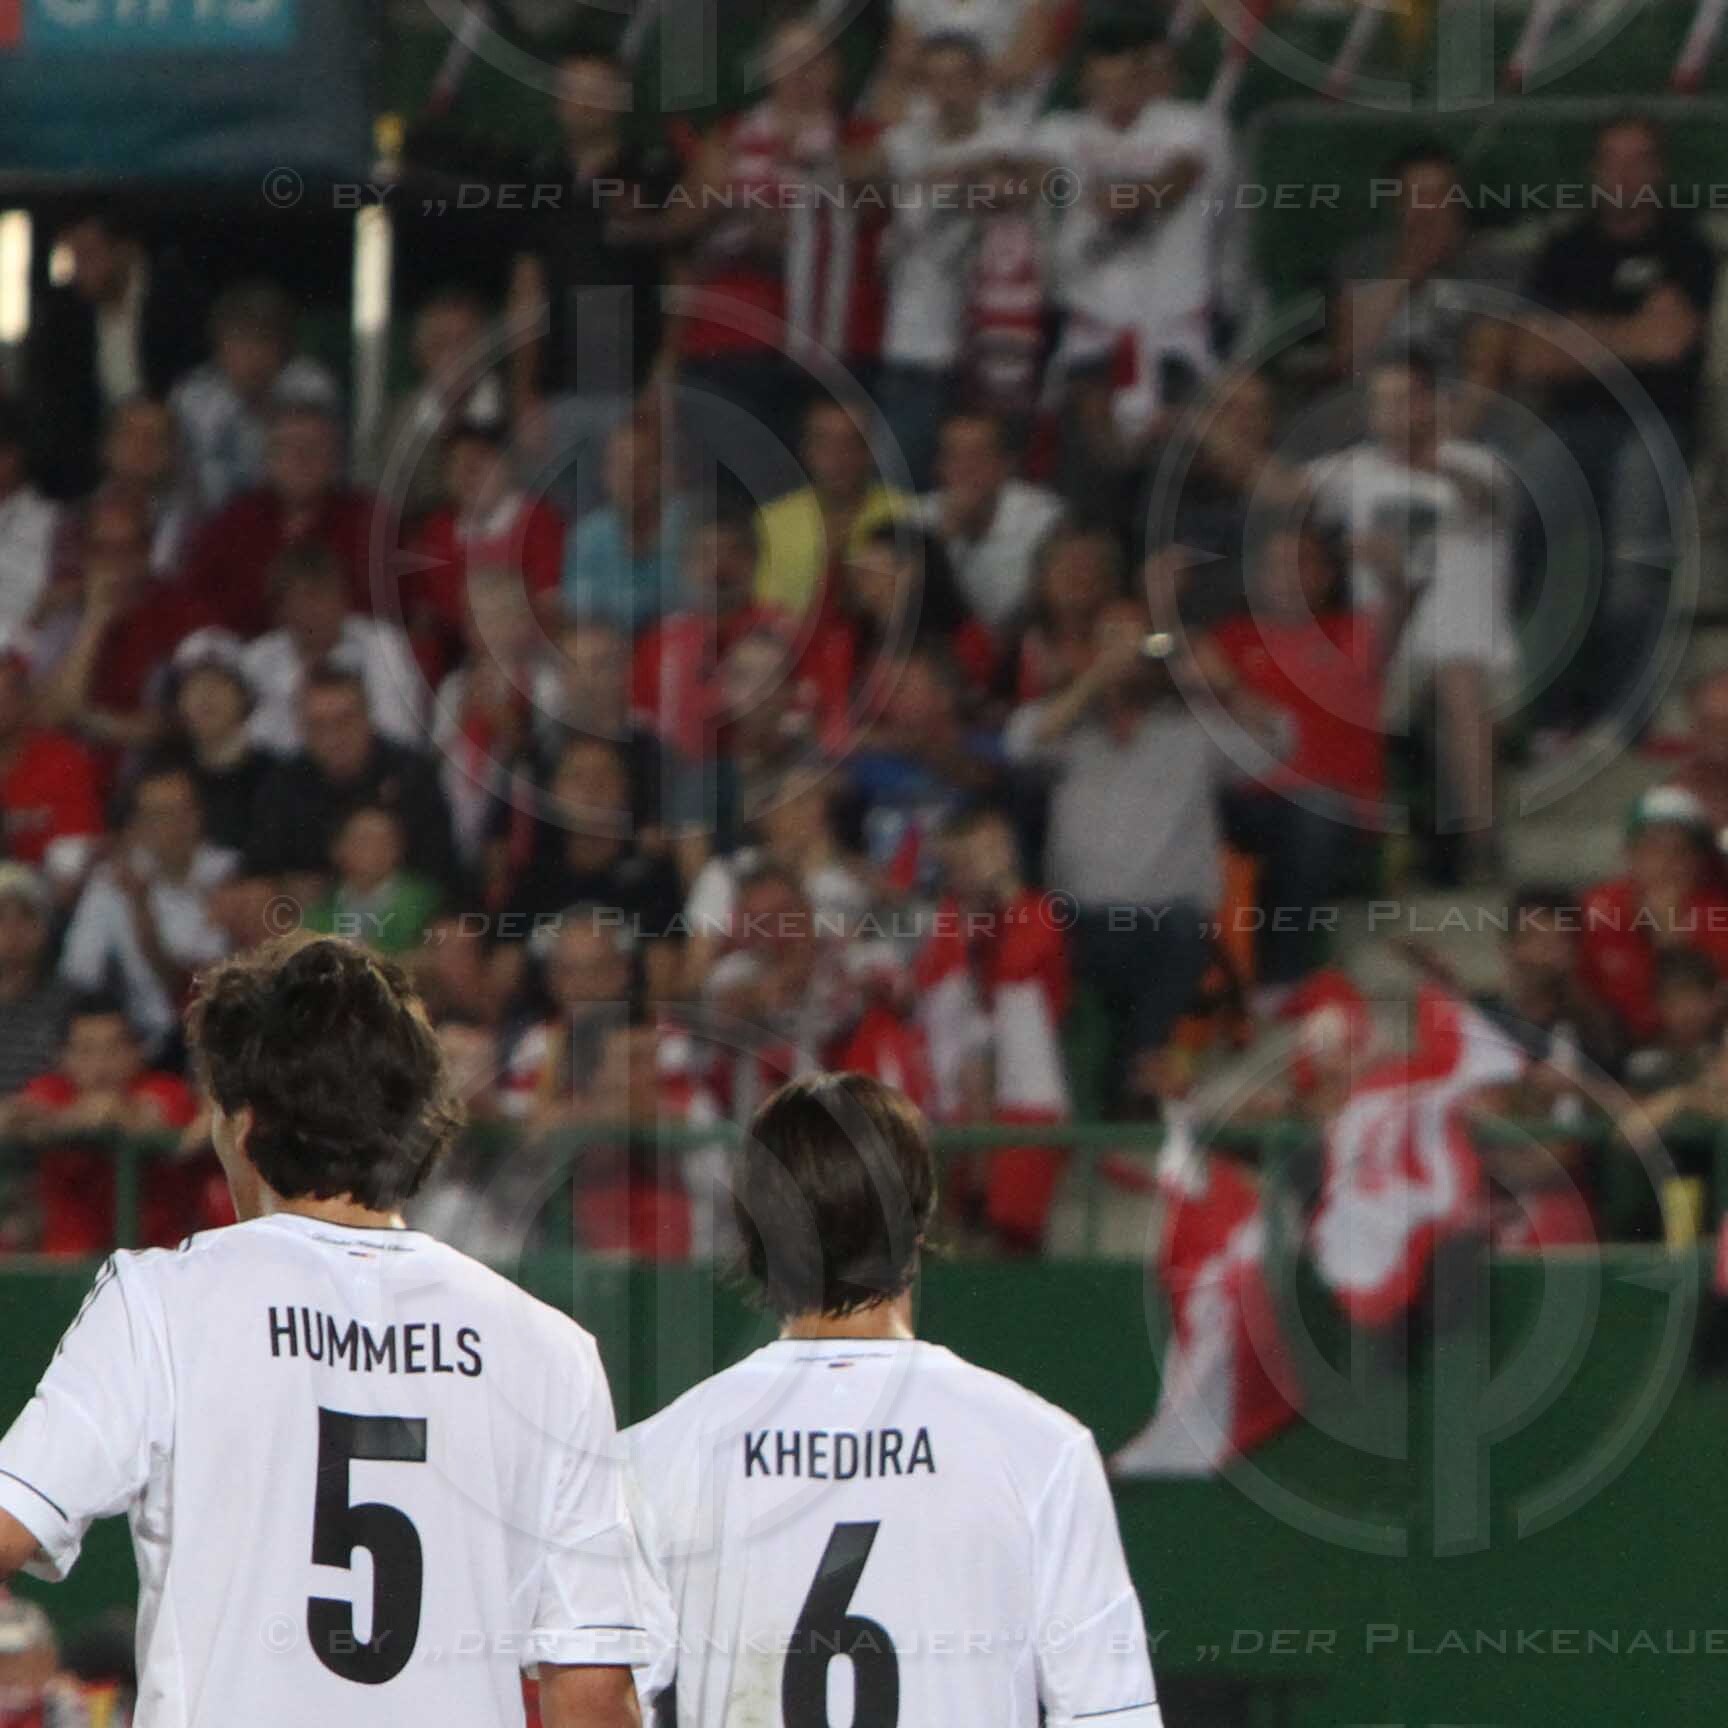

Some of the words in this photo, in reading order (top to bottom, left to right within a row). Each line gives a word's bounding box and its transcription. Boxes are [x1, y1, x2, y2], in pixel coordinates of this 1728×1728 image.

[267, 1305, 483, 1378] HUMMELS
[743, 1426, 937, 1481] KHEDIRA
[306, 1405, 428, 1685] 5
